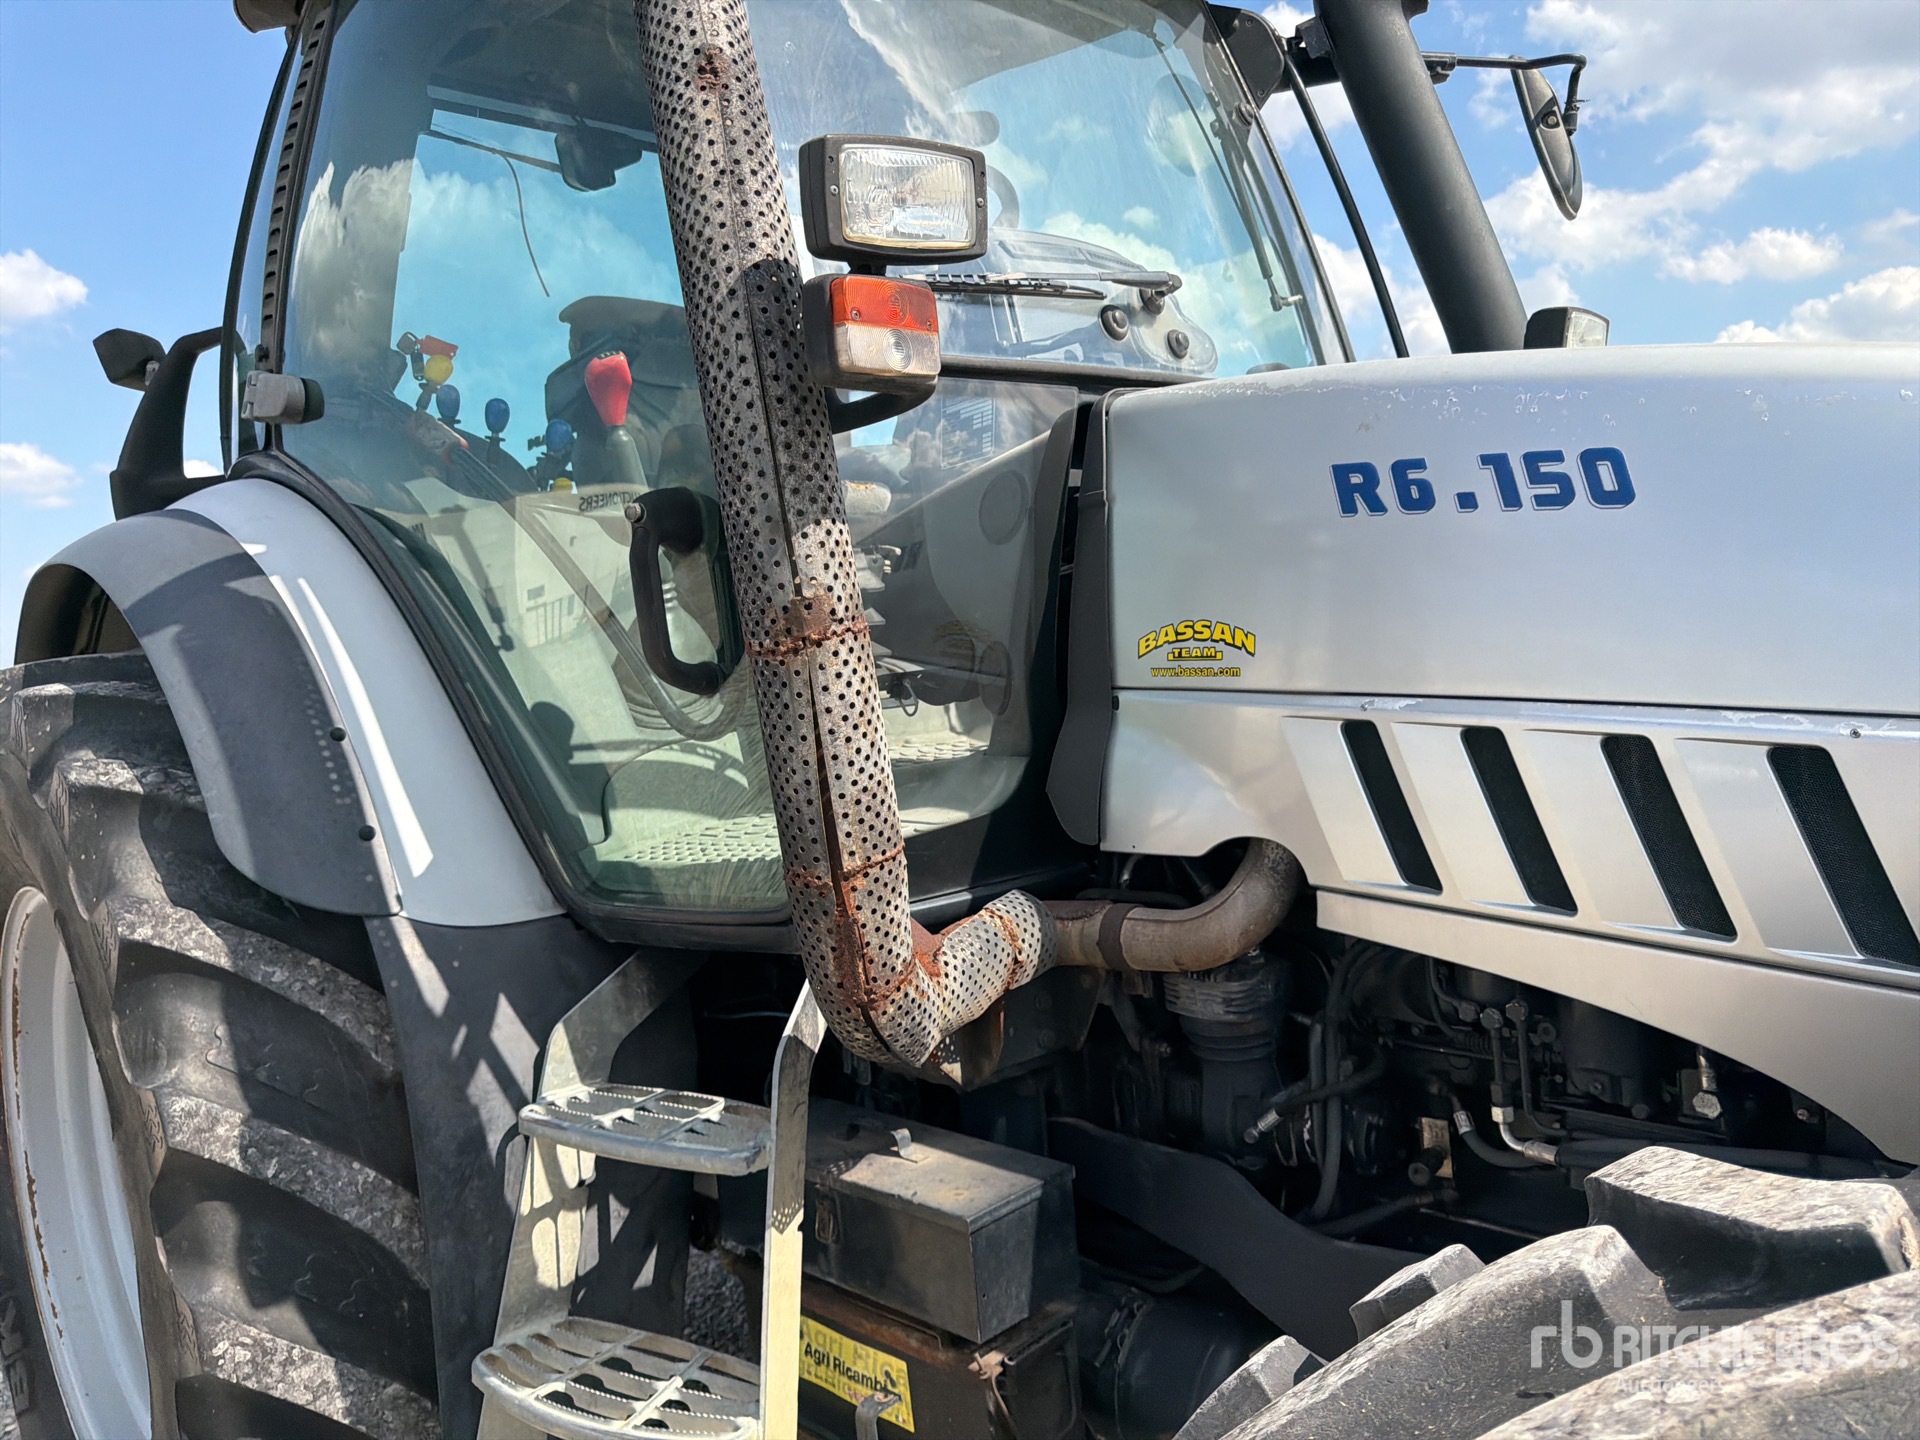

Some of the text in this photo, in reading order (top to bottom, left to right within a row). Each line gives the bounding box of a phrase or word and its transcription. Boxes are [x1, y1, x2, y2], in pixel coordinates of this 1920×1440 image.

[1138, 619, 1256, 659] BASSAN
[1172, 646, 1218, 659] TEAM
[1151, 665, 1241, 677] www.bassan.com
[804, 1341, 830, 1369] Agri
